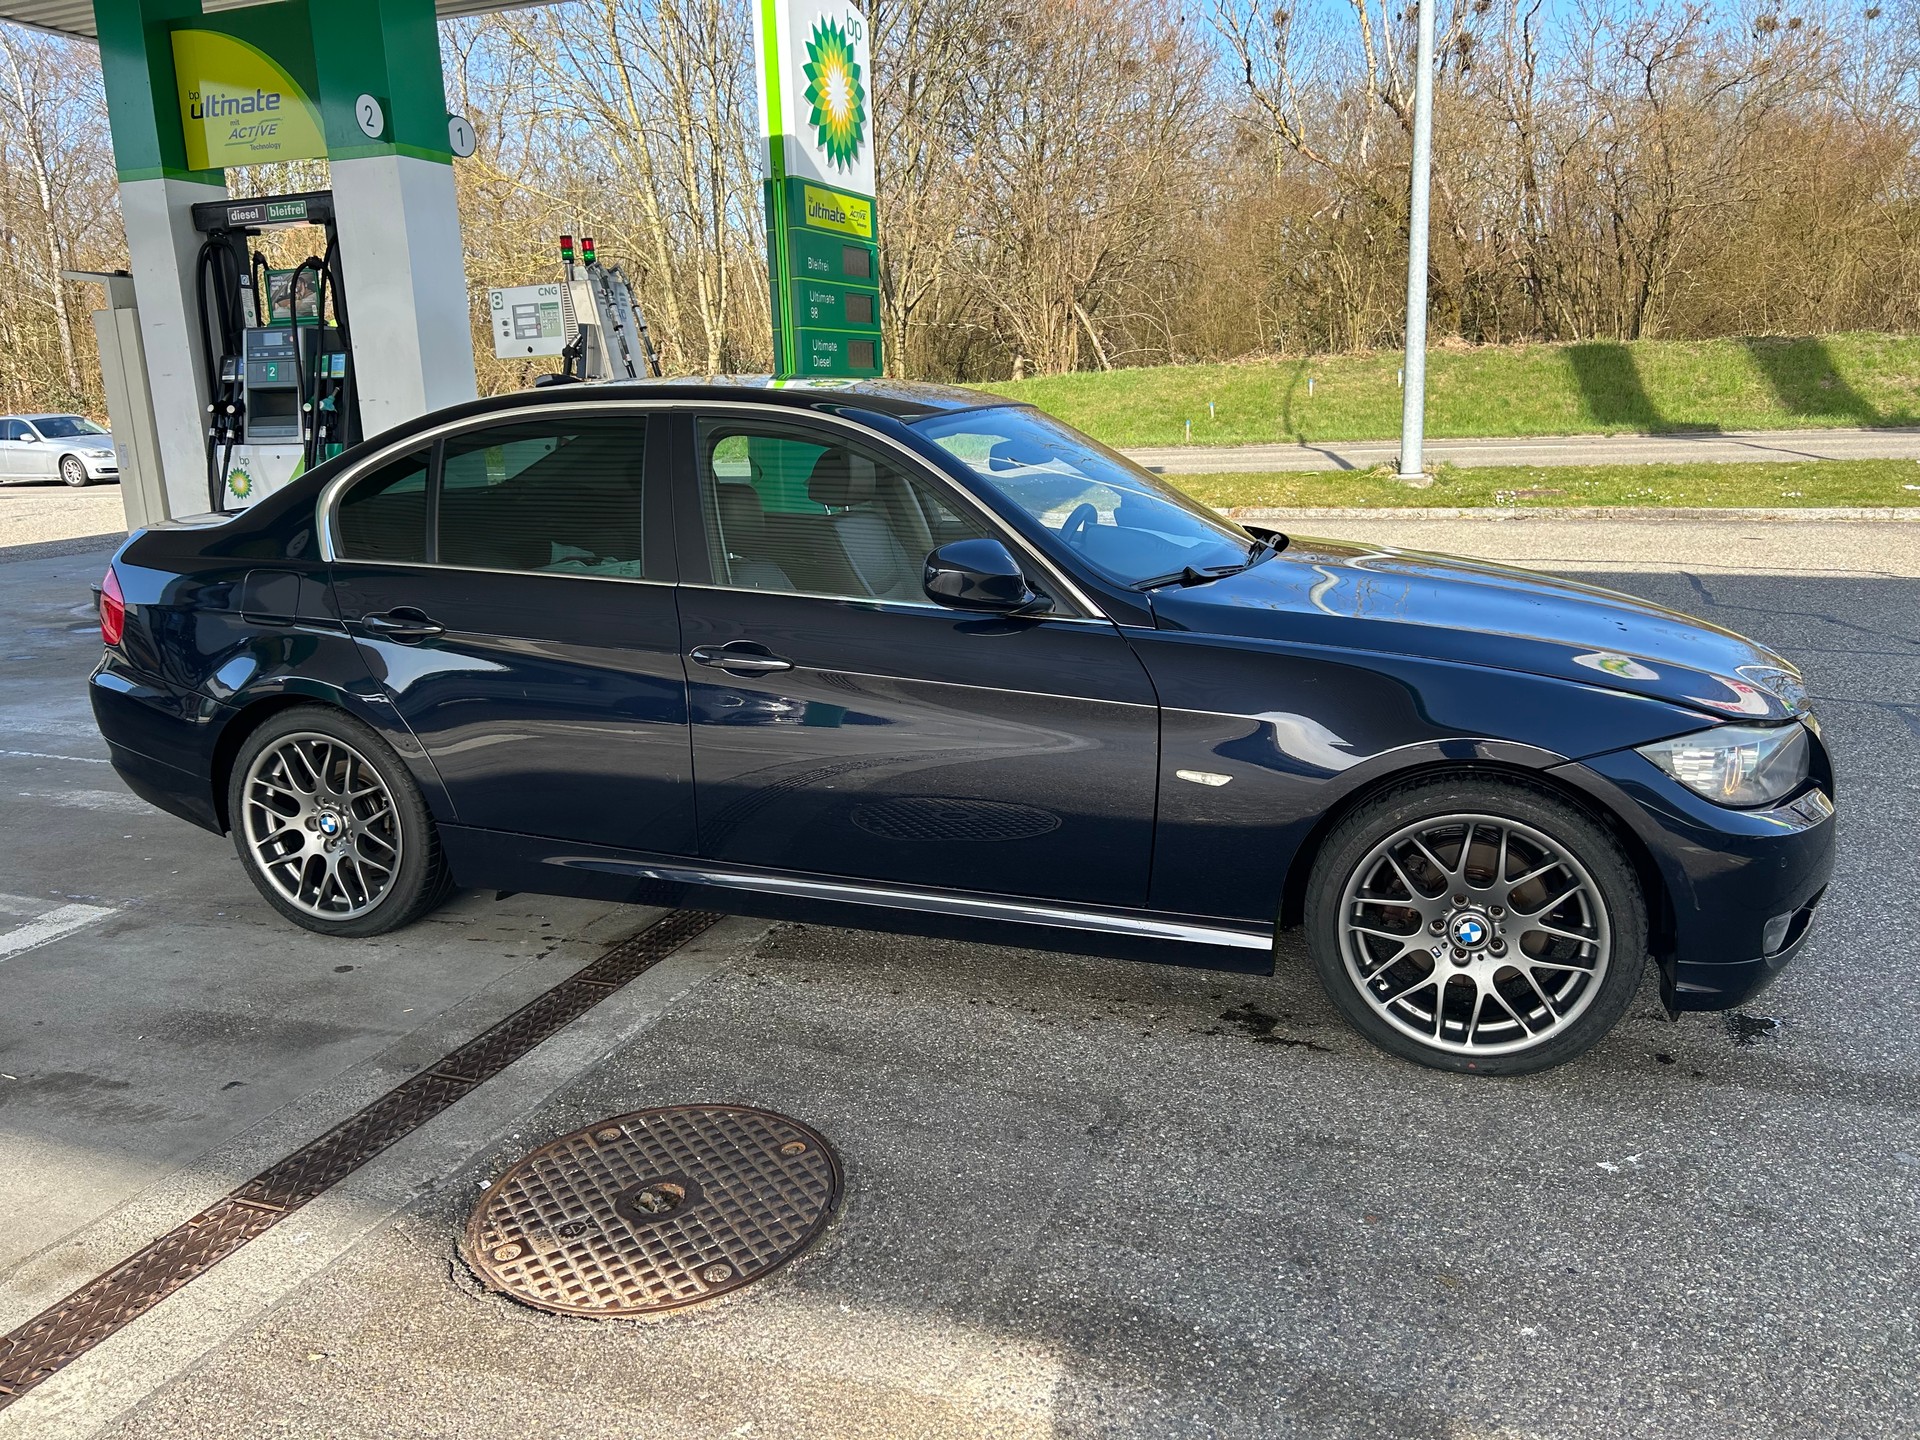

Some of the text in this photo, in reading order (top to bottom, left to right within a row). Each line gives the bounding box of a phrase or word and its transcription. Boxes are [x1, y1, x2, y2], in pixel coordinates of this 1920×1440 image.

[846, 9, 862, 45] bp
[188, 90, 200, 102] bp
[190, 88, 281, 120] ultimate
[364, 104, 375, 128] 2
[228, 123, 279, 140] ACTIVE
[456, 126, 465, 147] 1
[250, 142, 281, 151] Technology
[231, 203, 305, 221] diesel bleifrei
[808, 202, 846, 224] ultimate
[807, 256, 829, 272] Bleifrei
[538, 286, 558, 296] CNG
[809, 290, 835, 304] Ultimate
[492, 292, 503, 309] 8
[810, 306, 819, 319] 98
[812, 338, 838, 352] Ultimate
[812, 355, 832, 367] Diesel
[269, 366, 276, 377] 2
[238, 456, 250, 467] bp
